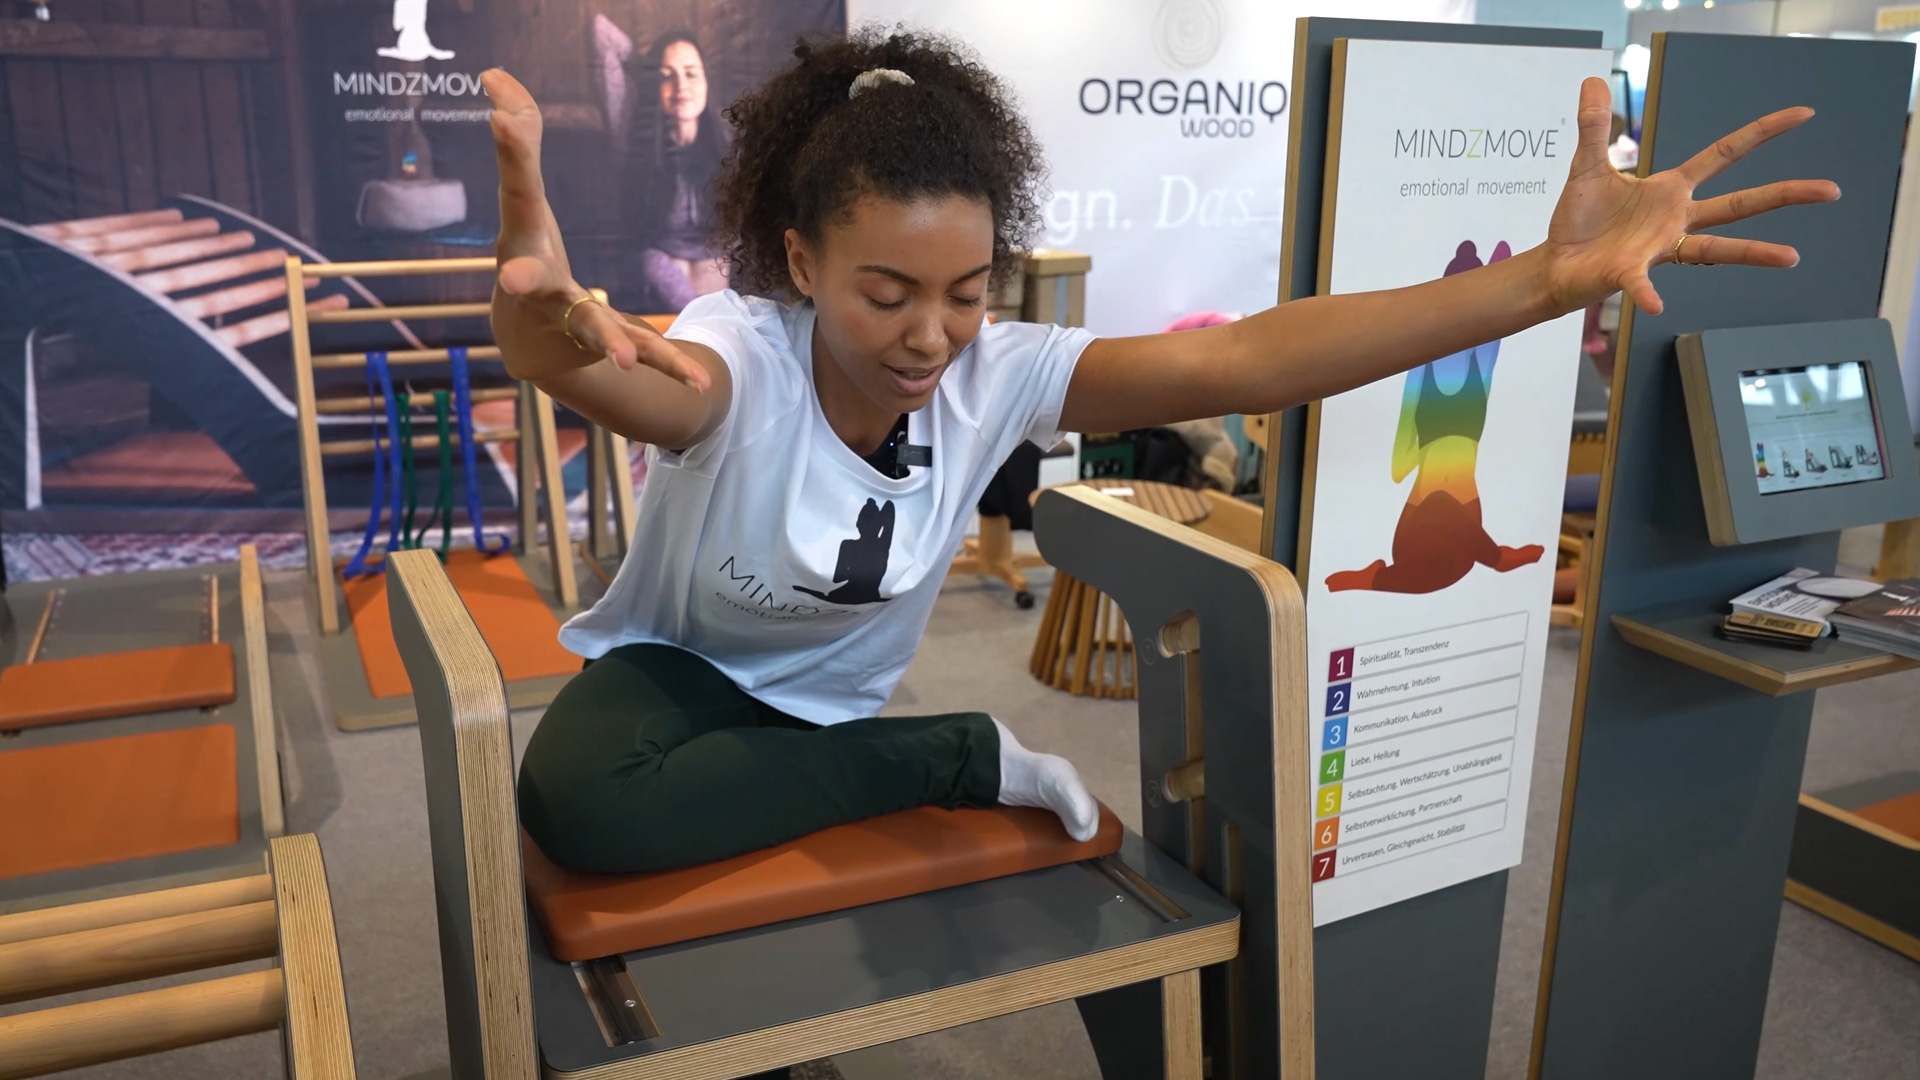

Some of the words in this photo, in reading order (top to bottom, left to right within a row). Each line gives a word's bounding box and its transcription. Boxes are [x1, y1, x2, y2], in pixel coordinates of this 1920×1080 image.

[333, 71, 489, 96] MINDZMOV
[1078, 78, 1288, 123] ORGANIQ
[345, 106, 414, 122] emotional
[1180, 118, 1255, 139] WOOD
[1394, 129, 1559, 158] MINDZMOVE
[1400, 178, 1469, 197] emotional
[1477, 178, 1547, 195] movement
[1336, 655, 1346, 677] 1
[1359, 650, 1402, 667] Spiritualität,
[1403, 640, 1450, 656] Transzendenz
[1332, 690, 1344, 711] 2
[1356, 682, 1410, 700] Wahrnehmung,
[1411, 675, 1441, 688] Intuition
[1329, 725, 1341, 745] 3
[1353, 714, 1410, 734] Kommunikation,
[1411, 705, 1443, 720] Ausdruck
[1326, 758, 1338, 778] 4
[1351, 756, 1372, 767] Liebe,
[1373, 749, 1401, 762] Heilung
[1324, 791, 1336, 812] 5
[1347, 781, 1398, 801] Selbstachtung,
[1452, 753, 1503, 773] Unabhängigkeit
[1321, 825, 1332, 844] 6
[1418, 794, 1463, 813] Partnerschaft
[1319, 857, 1330, 877] 7
[1341, 847, 1386, 866] Urvertrauen,
[1436, 823, 1466, 839] Stabilität
